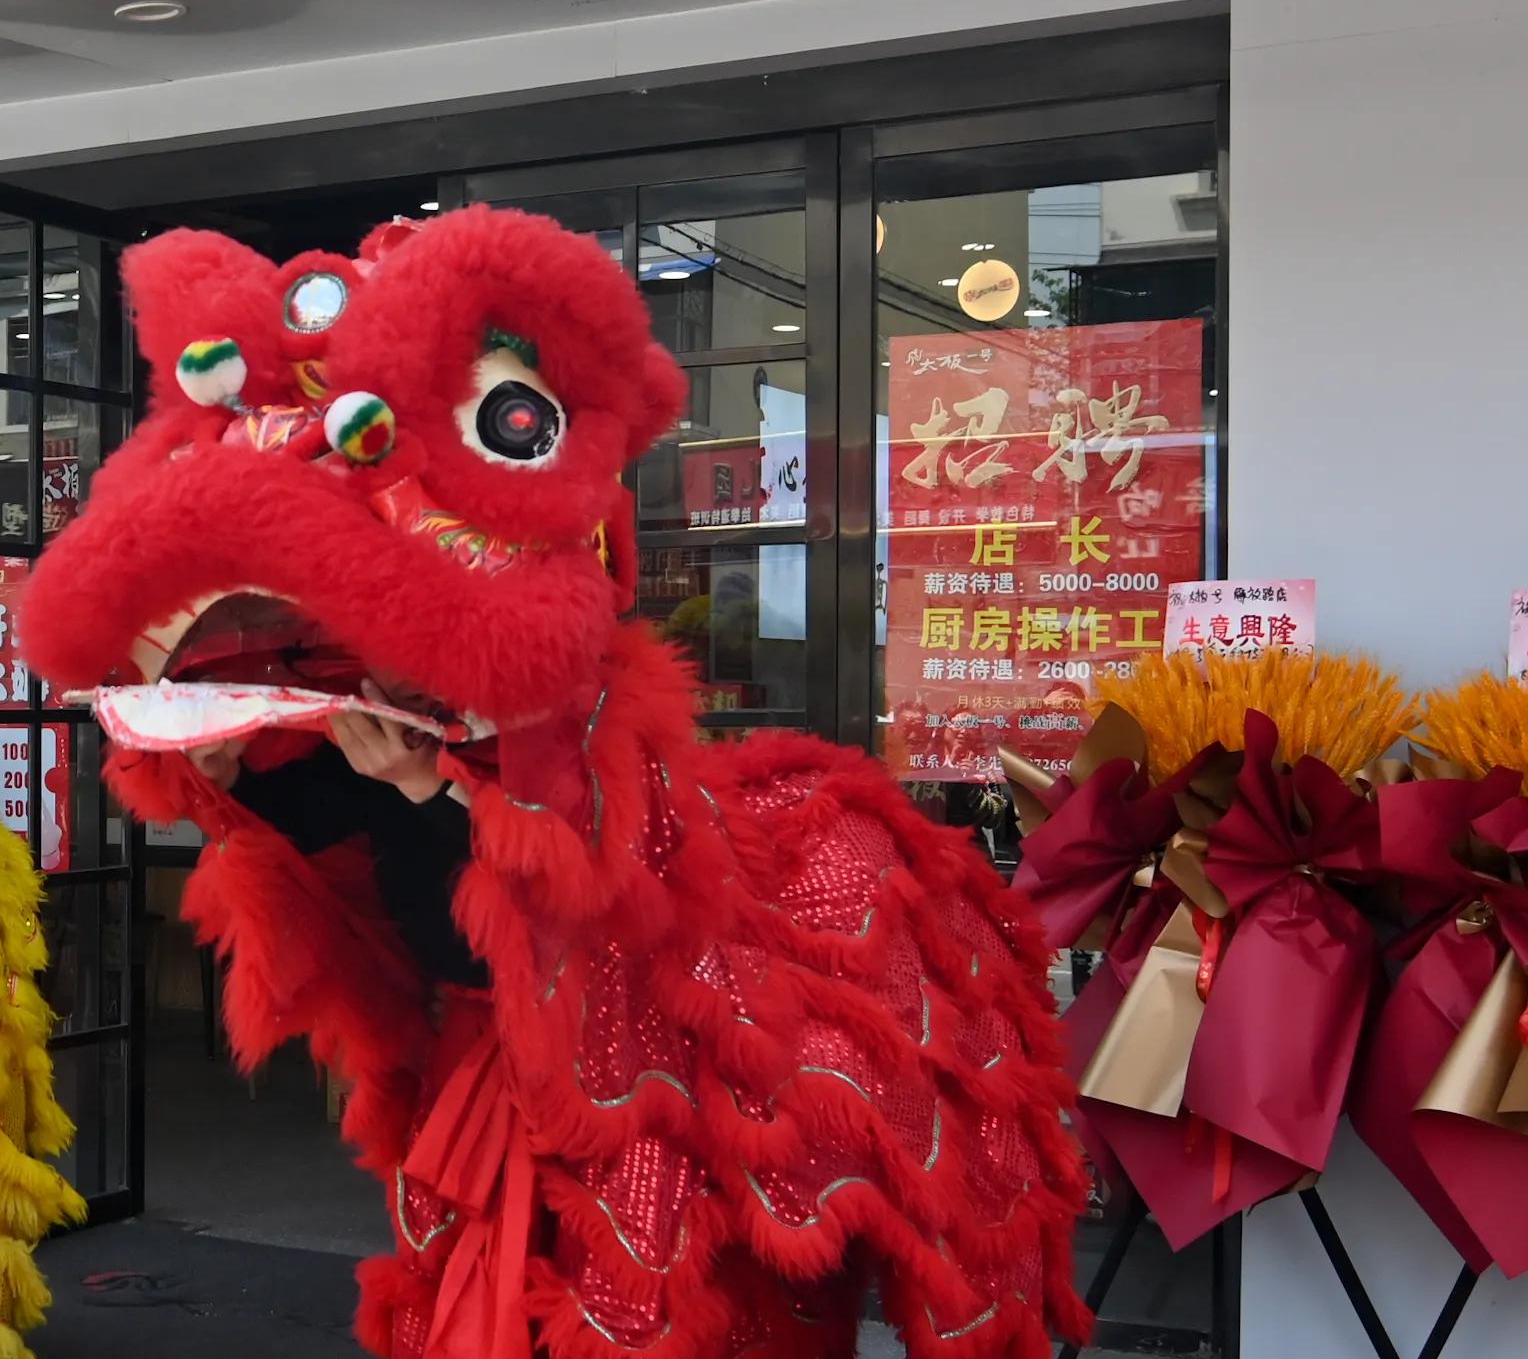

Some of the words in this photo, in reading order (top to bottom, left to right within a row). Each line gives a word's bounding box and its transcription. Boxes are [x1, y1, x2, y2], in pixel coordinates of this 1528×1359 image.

[901, 380, 1169, 493] 招聘
[919, 607, 1163, 653] 厨房操作工
